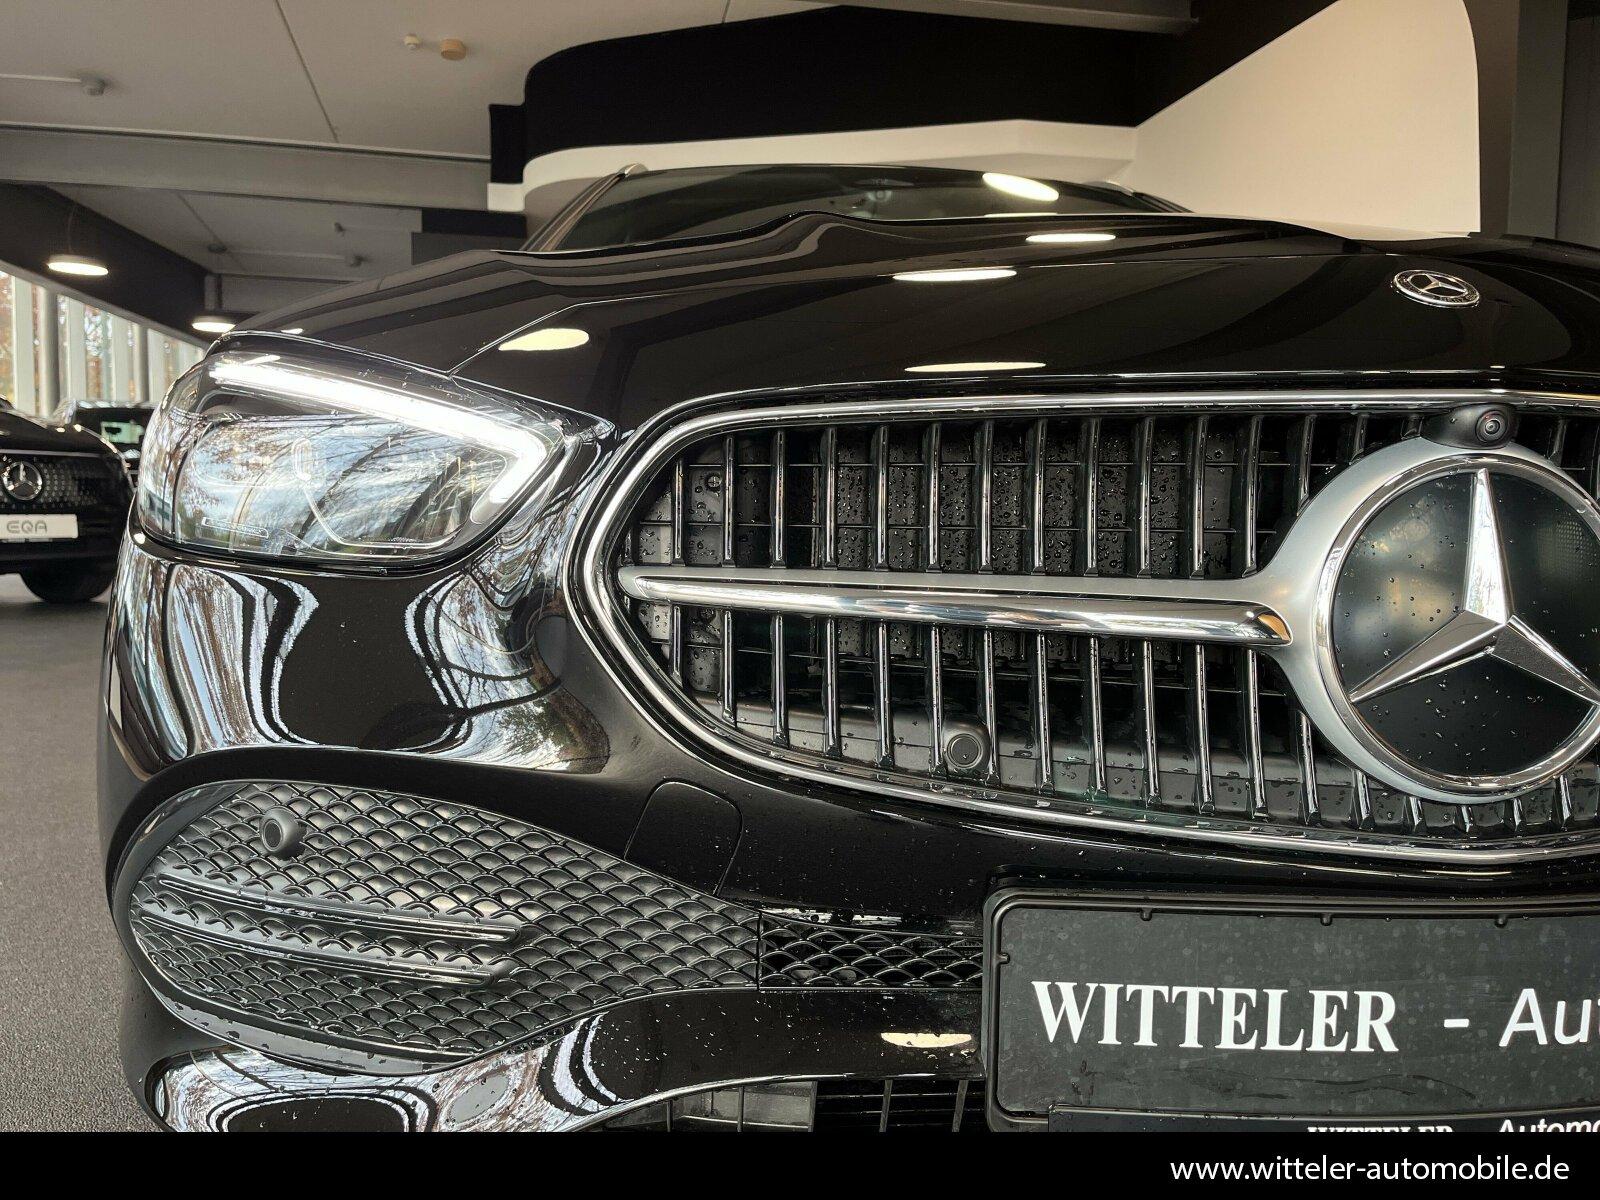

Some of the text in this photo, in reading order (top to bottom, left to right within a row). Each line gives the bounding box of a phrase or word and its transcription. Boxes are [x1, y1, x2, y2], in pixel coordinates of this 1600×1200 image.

[7, 520, 48, 534] EQA
[1030, 980, 1400, 1053] WITTELER
[1499, 988, 1600, 1047] Au
